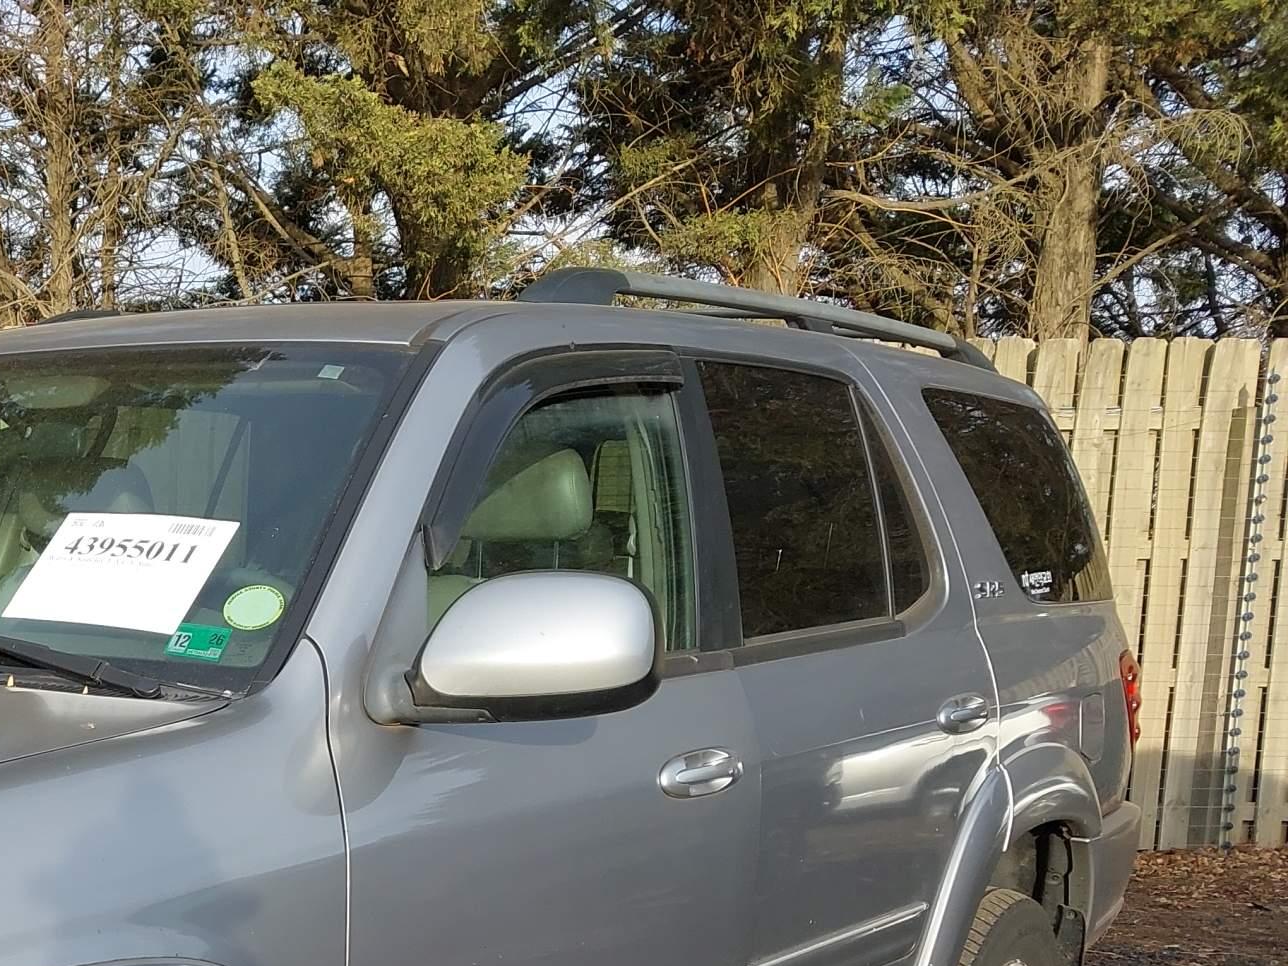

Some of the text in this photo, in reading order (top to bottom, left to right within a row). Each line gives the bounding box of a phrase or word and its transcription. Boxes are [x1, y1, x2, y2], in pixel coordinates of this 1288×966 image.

[64, 535, 198, 564] 43955011
[174, 633, 226, 648] 12 26
